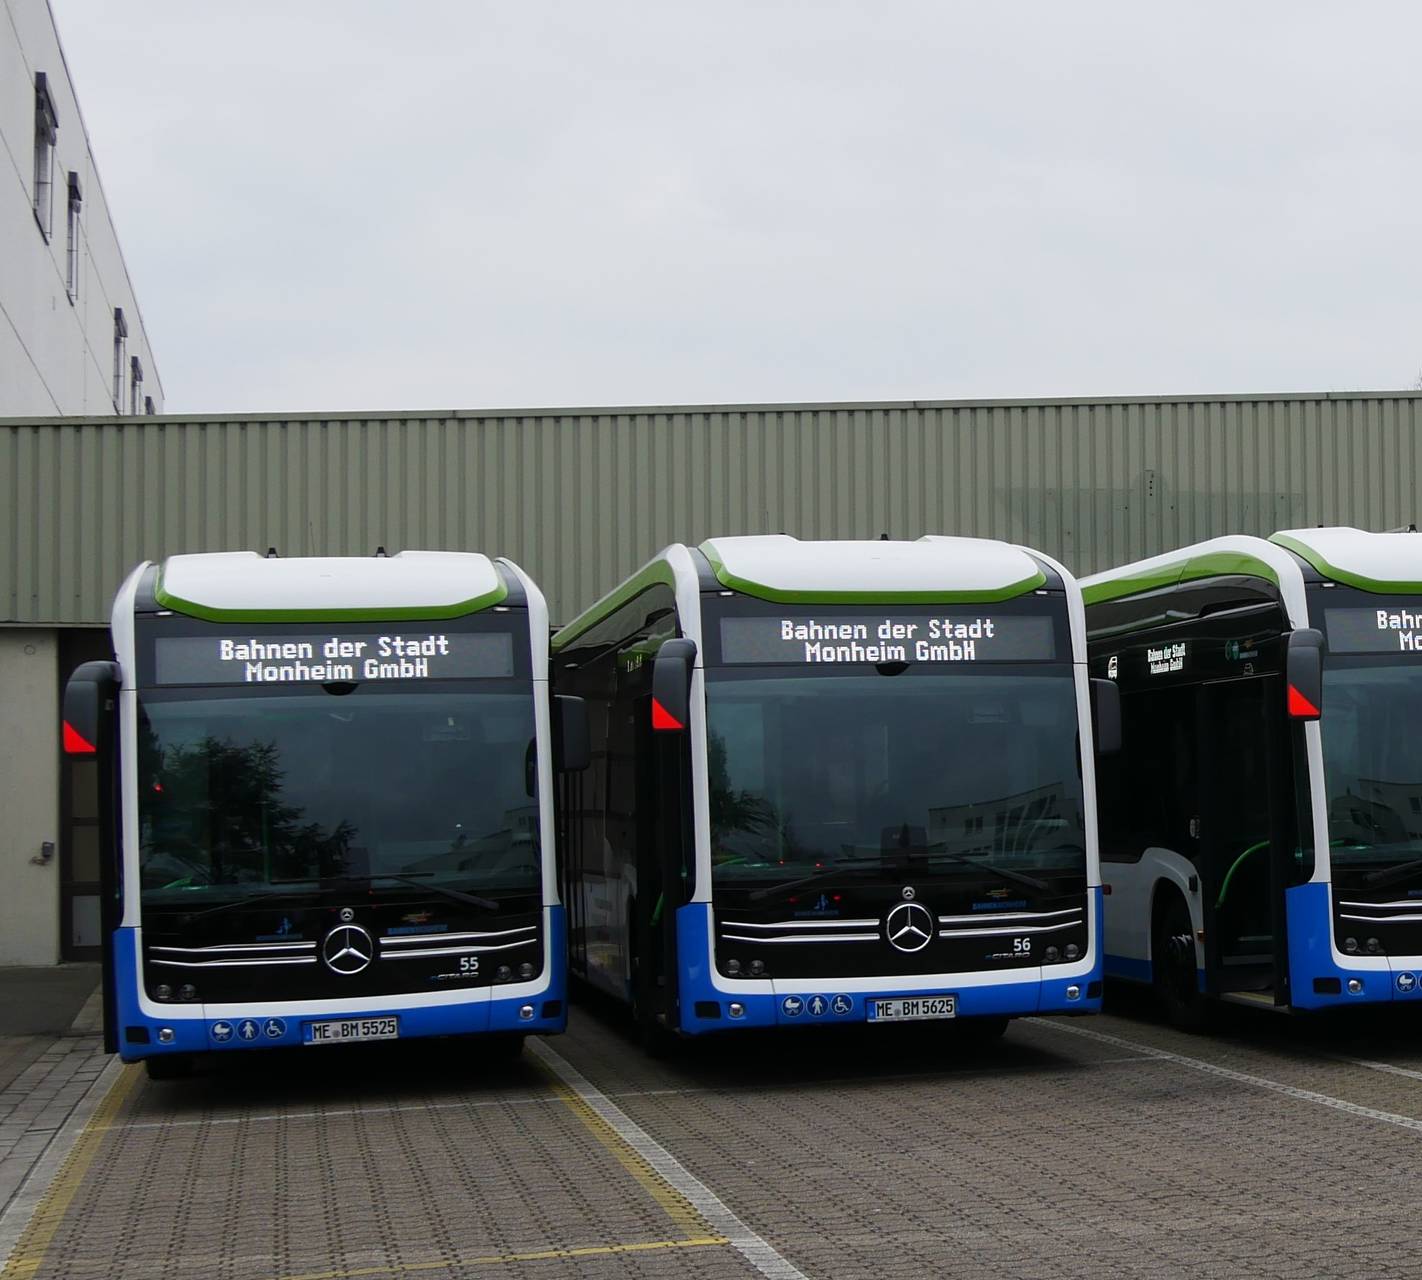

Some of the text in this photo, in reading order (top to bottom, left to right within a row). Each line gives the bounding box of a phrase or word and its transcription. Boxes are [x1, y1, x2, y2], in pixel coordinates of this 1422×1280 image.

[781, 618, 994, 640] Bahnen der Stadt
[219, 635, 449, 661] Bahnen der Stadt
[805, 640, 976, 662] Monheim GmbH
[245, 658, 429, 682] Monheim GmbH
[1013, 938, 1031, 951] 56
[460, 957, 479, 970] 55
[876, 999, 953, 1017] ME BM 5625
[313, 1020, 396, 1039] ME BM 5525
